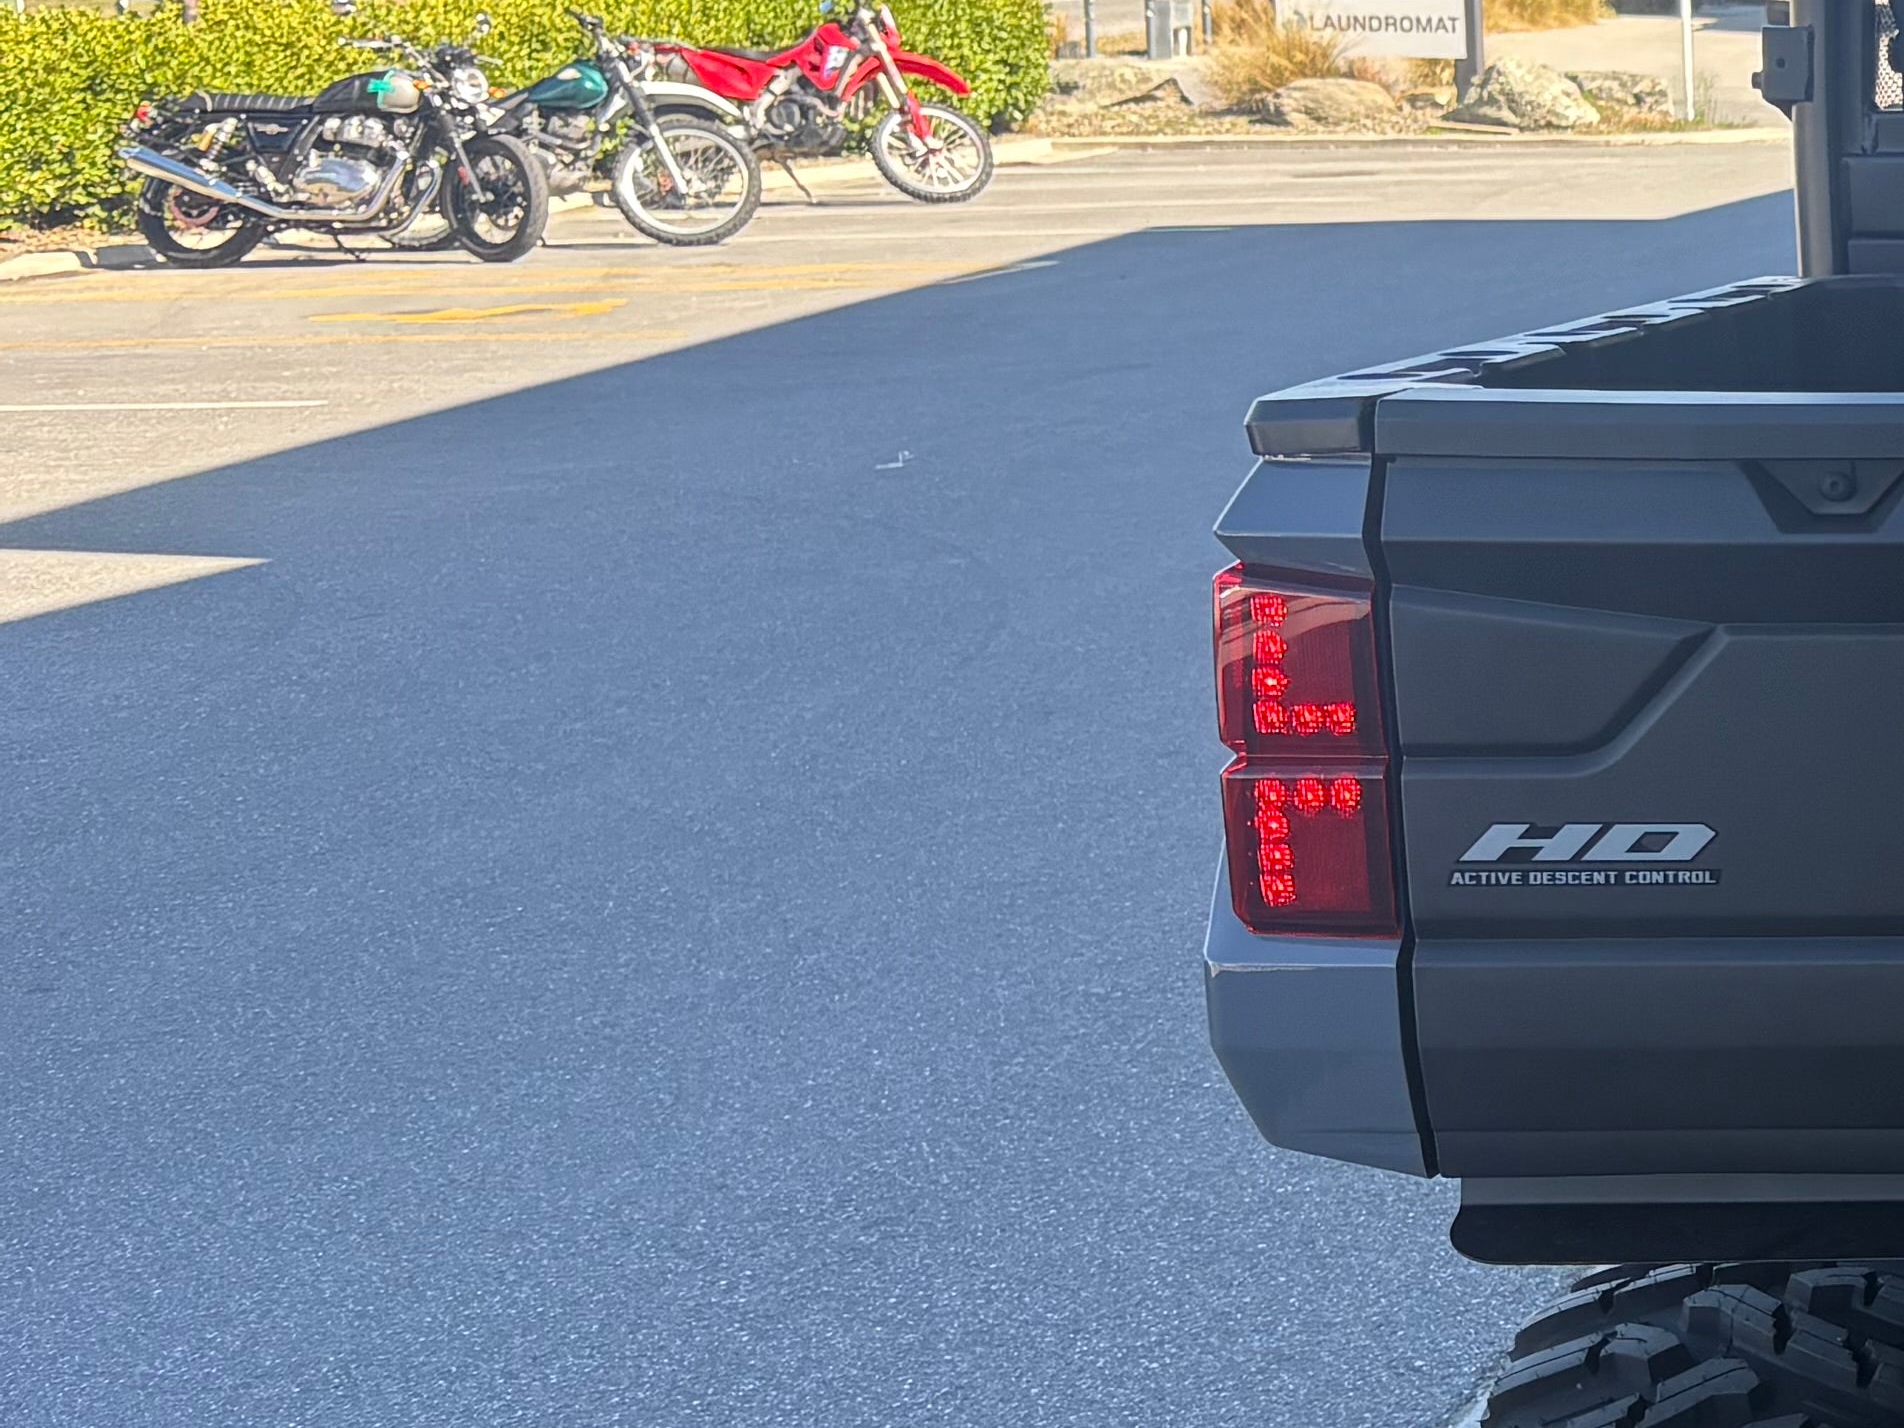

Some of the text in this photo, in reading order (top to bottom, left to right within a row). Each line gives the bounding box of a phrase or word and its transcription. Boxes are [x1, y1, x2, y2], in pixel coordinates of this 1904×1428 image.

[1308, 14, 1461, 35] LAUNDROMAT
[1457, 823, 1718, 862] HD
[1450, 870, 1718, 886] ACTIVE DESCENT CONTROL
